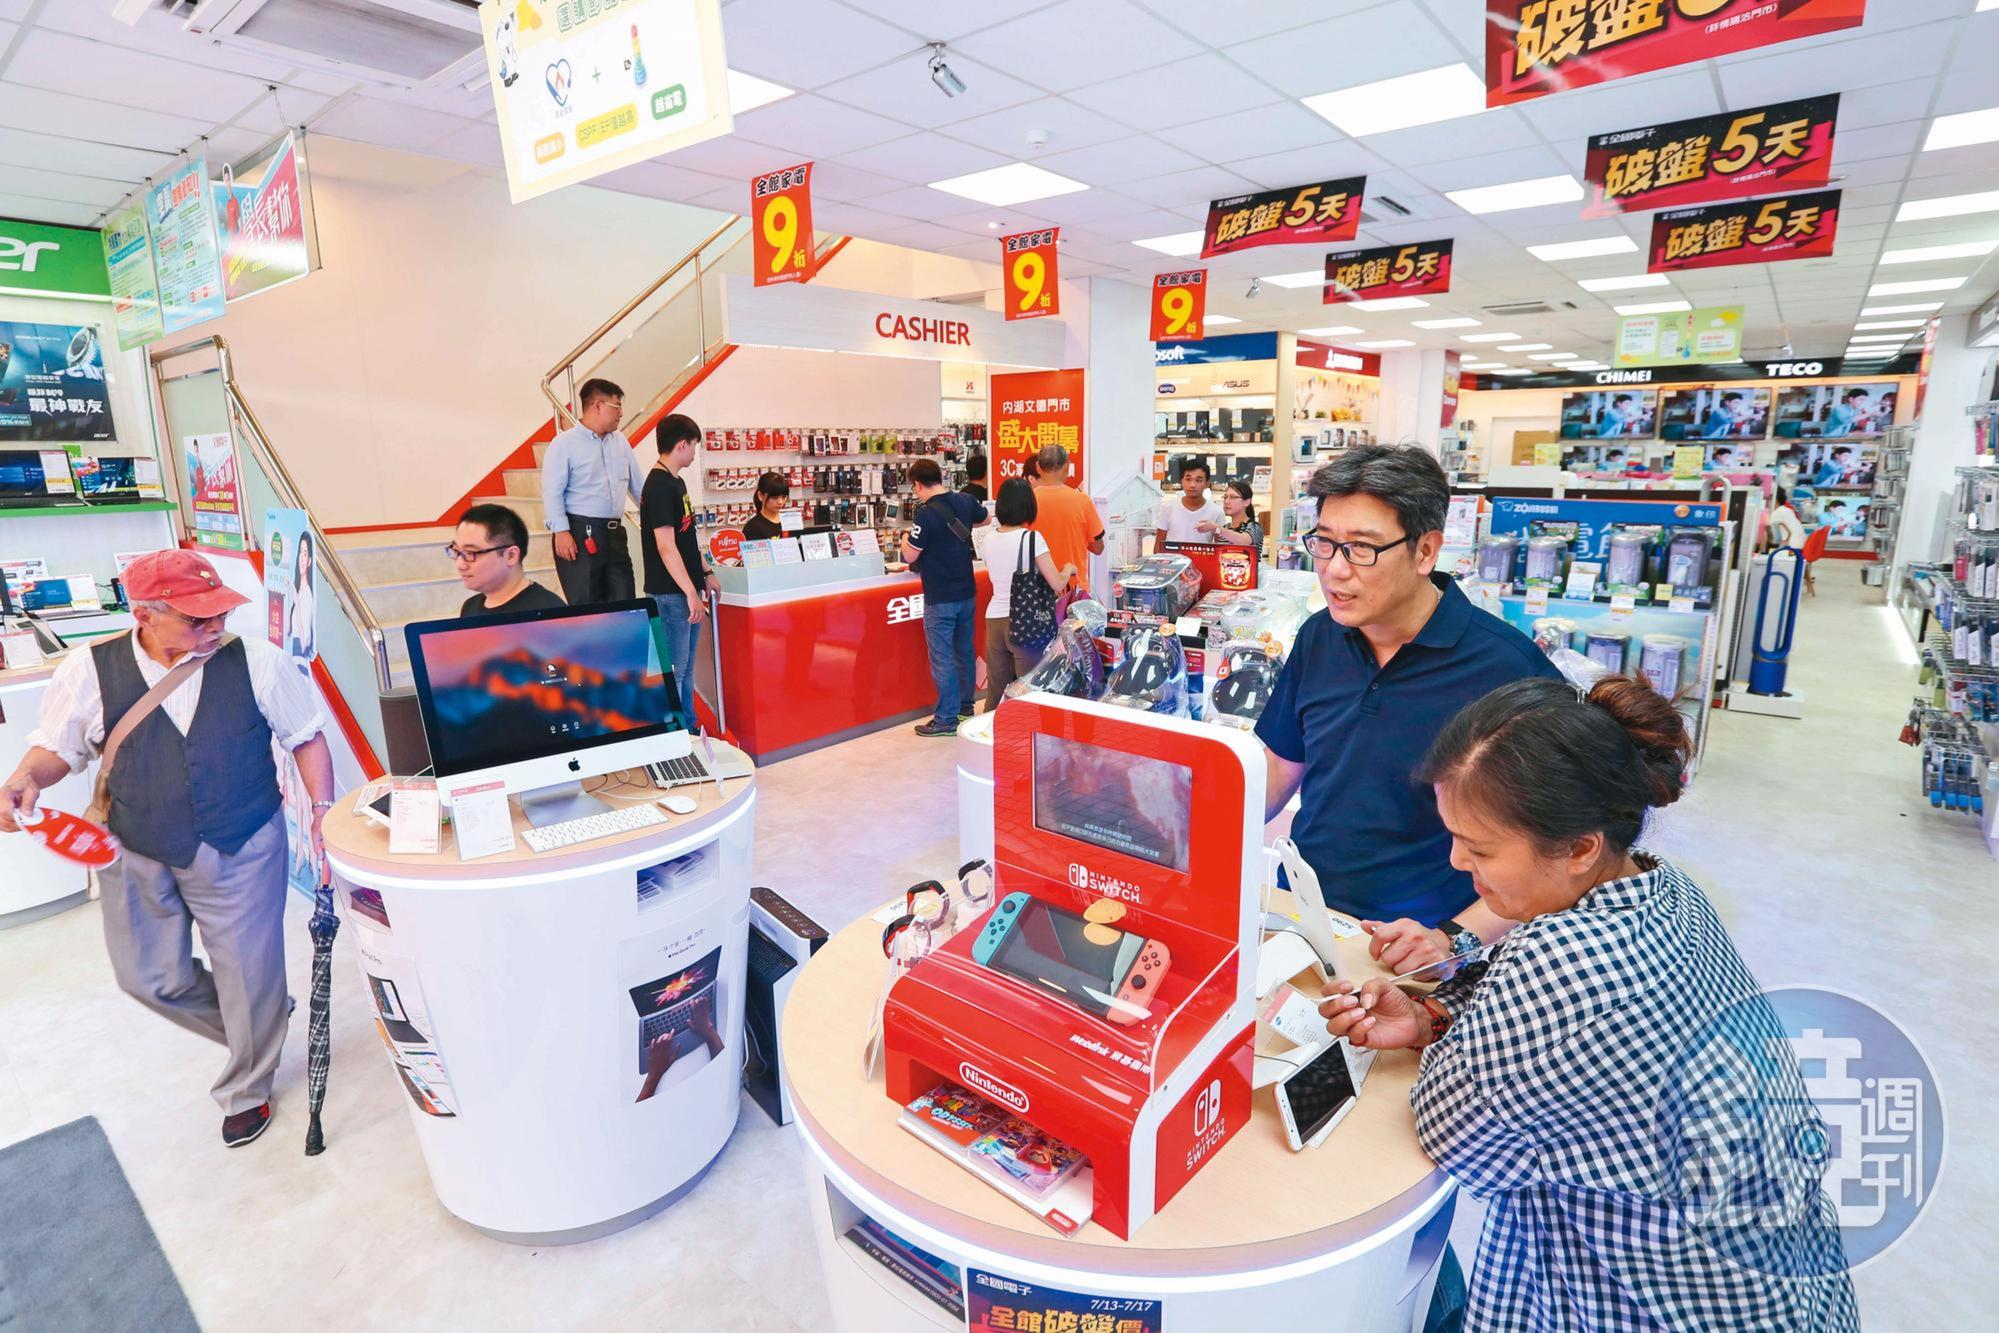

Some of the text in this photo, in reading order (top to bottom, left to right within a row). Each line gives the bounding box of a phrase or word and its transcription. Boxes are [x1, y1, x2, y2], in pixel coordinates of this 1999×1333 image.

[1604, 112, 1809, 199] 破盤5天
[756, 165, 808, 198] 全館家電
[1214, 185, 1348, 245] 破盤5天
[1665, 200, 1820, 260] 破盤5天
[1007, 230, 1055, 253] 全館家電
[1157, 272, 1202, 288] 全館家電
[1334, 245, 1440, 294] 破盤5天
[875, 312, 971, 346] CASHIER
[1223, 380, 1251, 388] ASUS
[1596, 370, 1652, 384] CHIMEI
[1766, 361, 1823, 377] TECO
[29, 397, 104, 416] 最神戰友
[997, 419, 1079, 454] 盛大開幕
[1089, 871, 1141, 892] NINTENDO
[1089, 878, 1143, 904] SWITCH
[964, 1067, 1025, 1107] Nintendo
[1186, 1125, 1227, 1171] SWITCH
[1187, 1117, 1225, 1158] NINTENDO
[976, 1273, 1032, 1296] 全國電子
